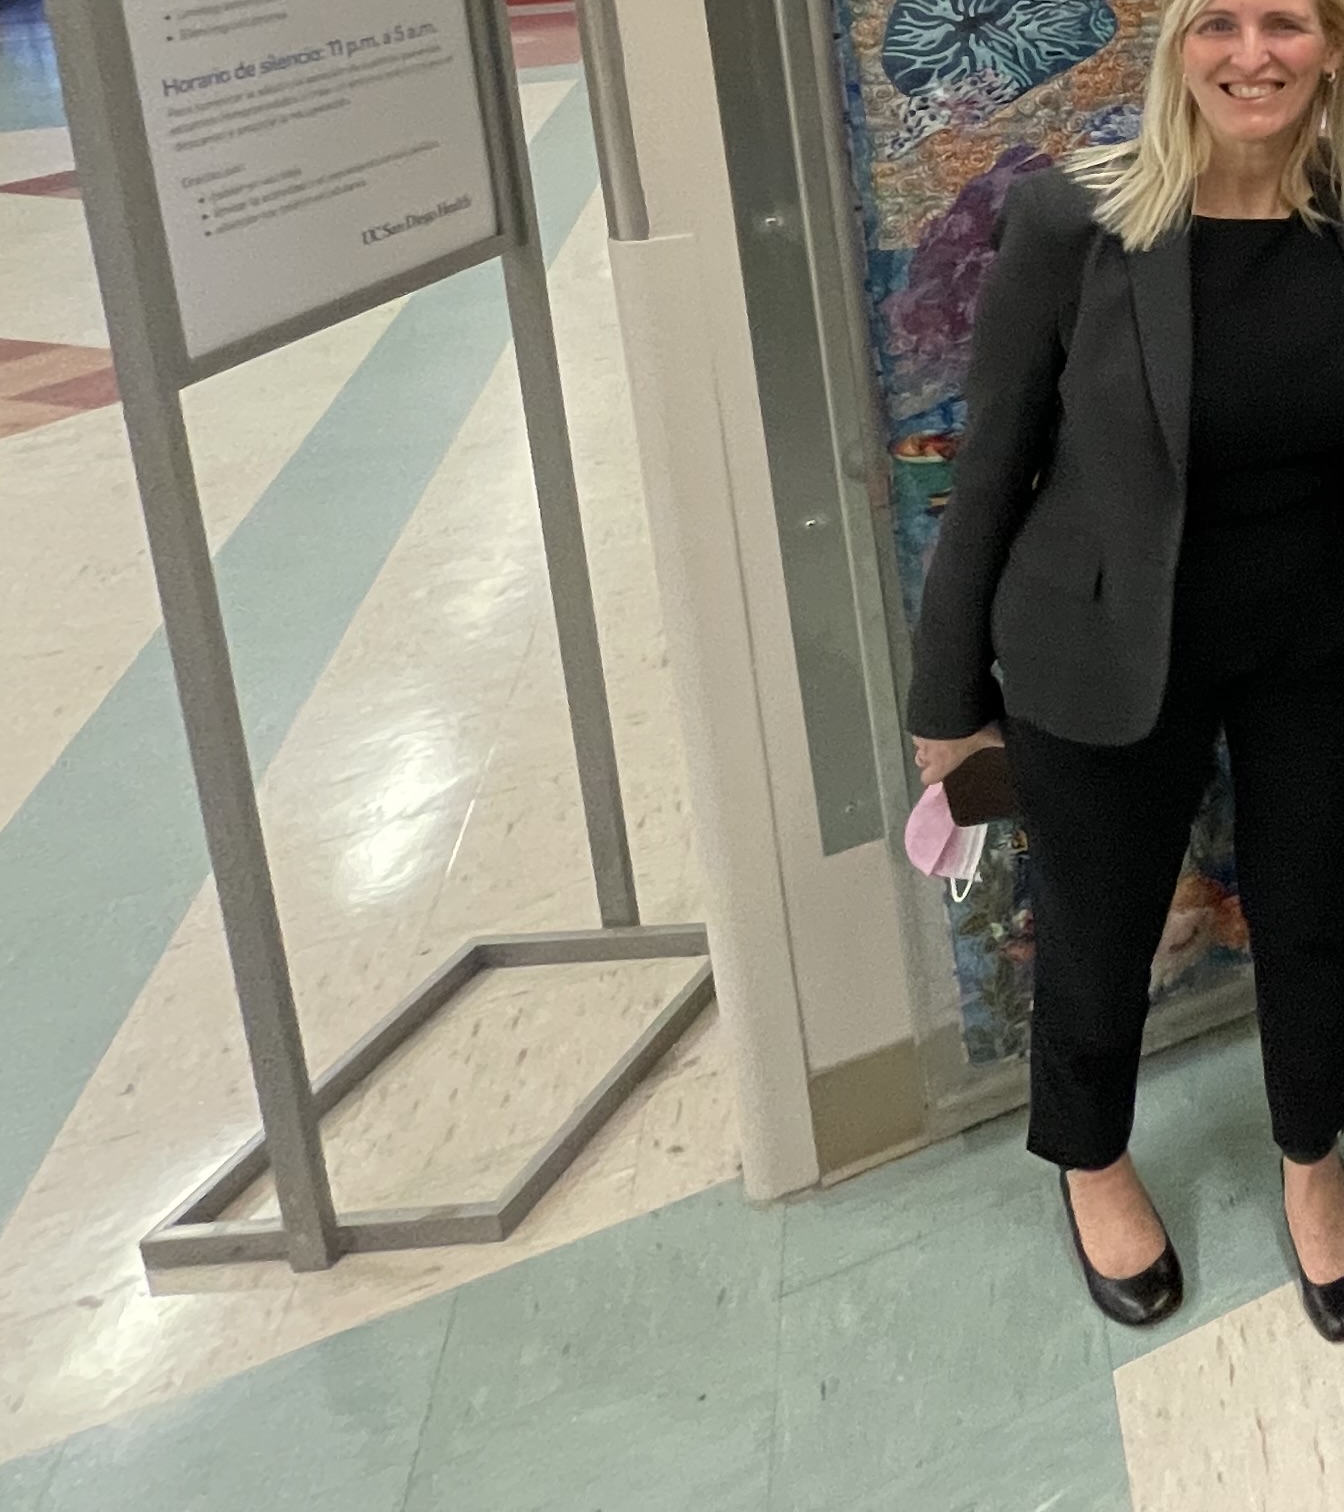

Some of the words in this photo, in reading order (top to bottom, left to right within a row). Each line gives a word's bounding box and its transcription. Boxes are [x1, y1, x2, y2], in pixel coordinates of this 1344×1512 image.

[162, 70, 232, 97] Horario
[233, 62, 257, 80] de
[260, 52, 325, 74] silencio:
[325, 39, 343, 57] 11
[345, 35, 380, 59] p.m.
[382, 33, 392, 45] a
[394, 25, 405, 45] 5
[406, 23, 437, 40] a.m.
